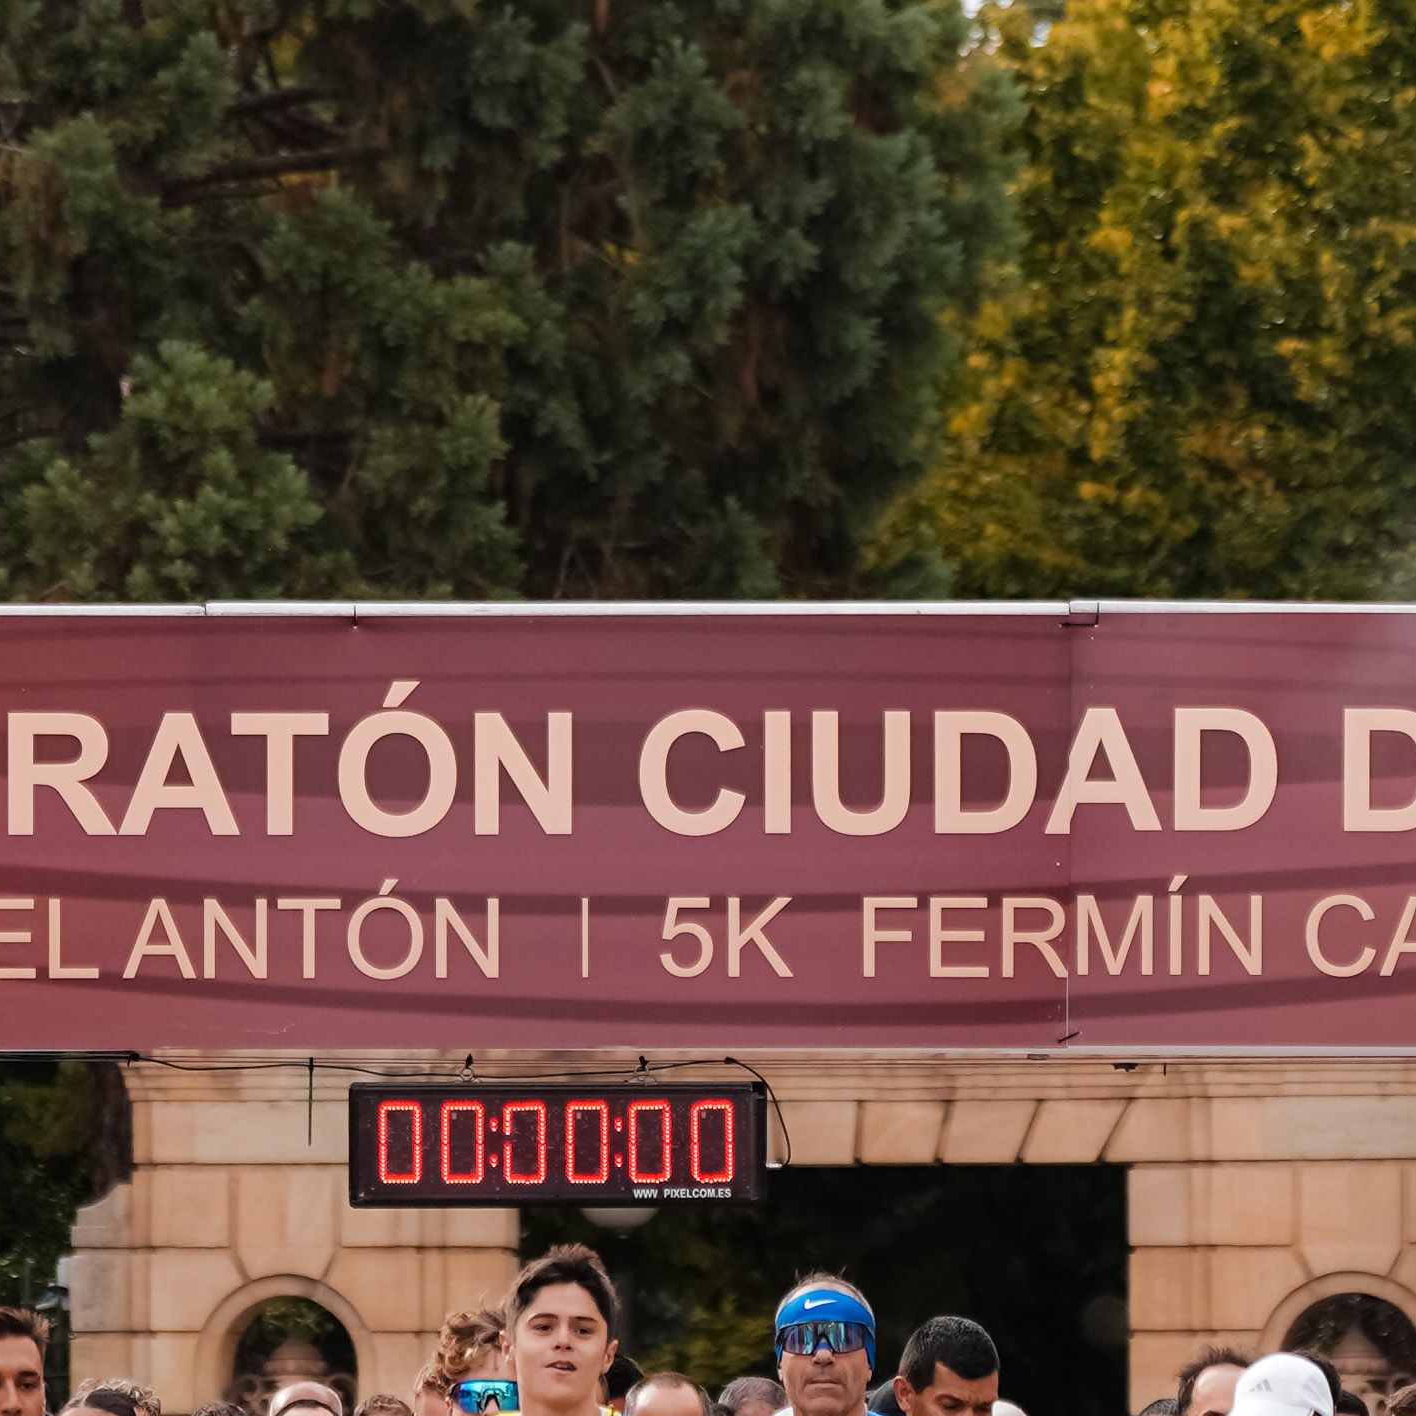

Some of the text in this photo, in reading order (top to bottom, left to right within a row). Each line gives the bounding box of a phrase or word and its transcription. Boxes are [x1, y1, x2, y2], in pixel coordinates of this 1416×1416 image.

[638, 708, 1278, 836] CIUDAD
[122, 879, 500, 980] ANTÓN
[659, 897, 794, 978] 5K
[862, 875, 1262, 978] FERMÍN
